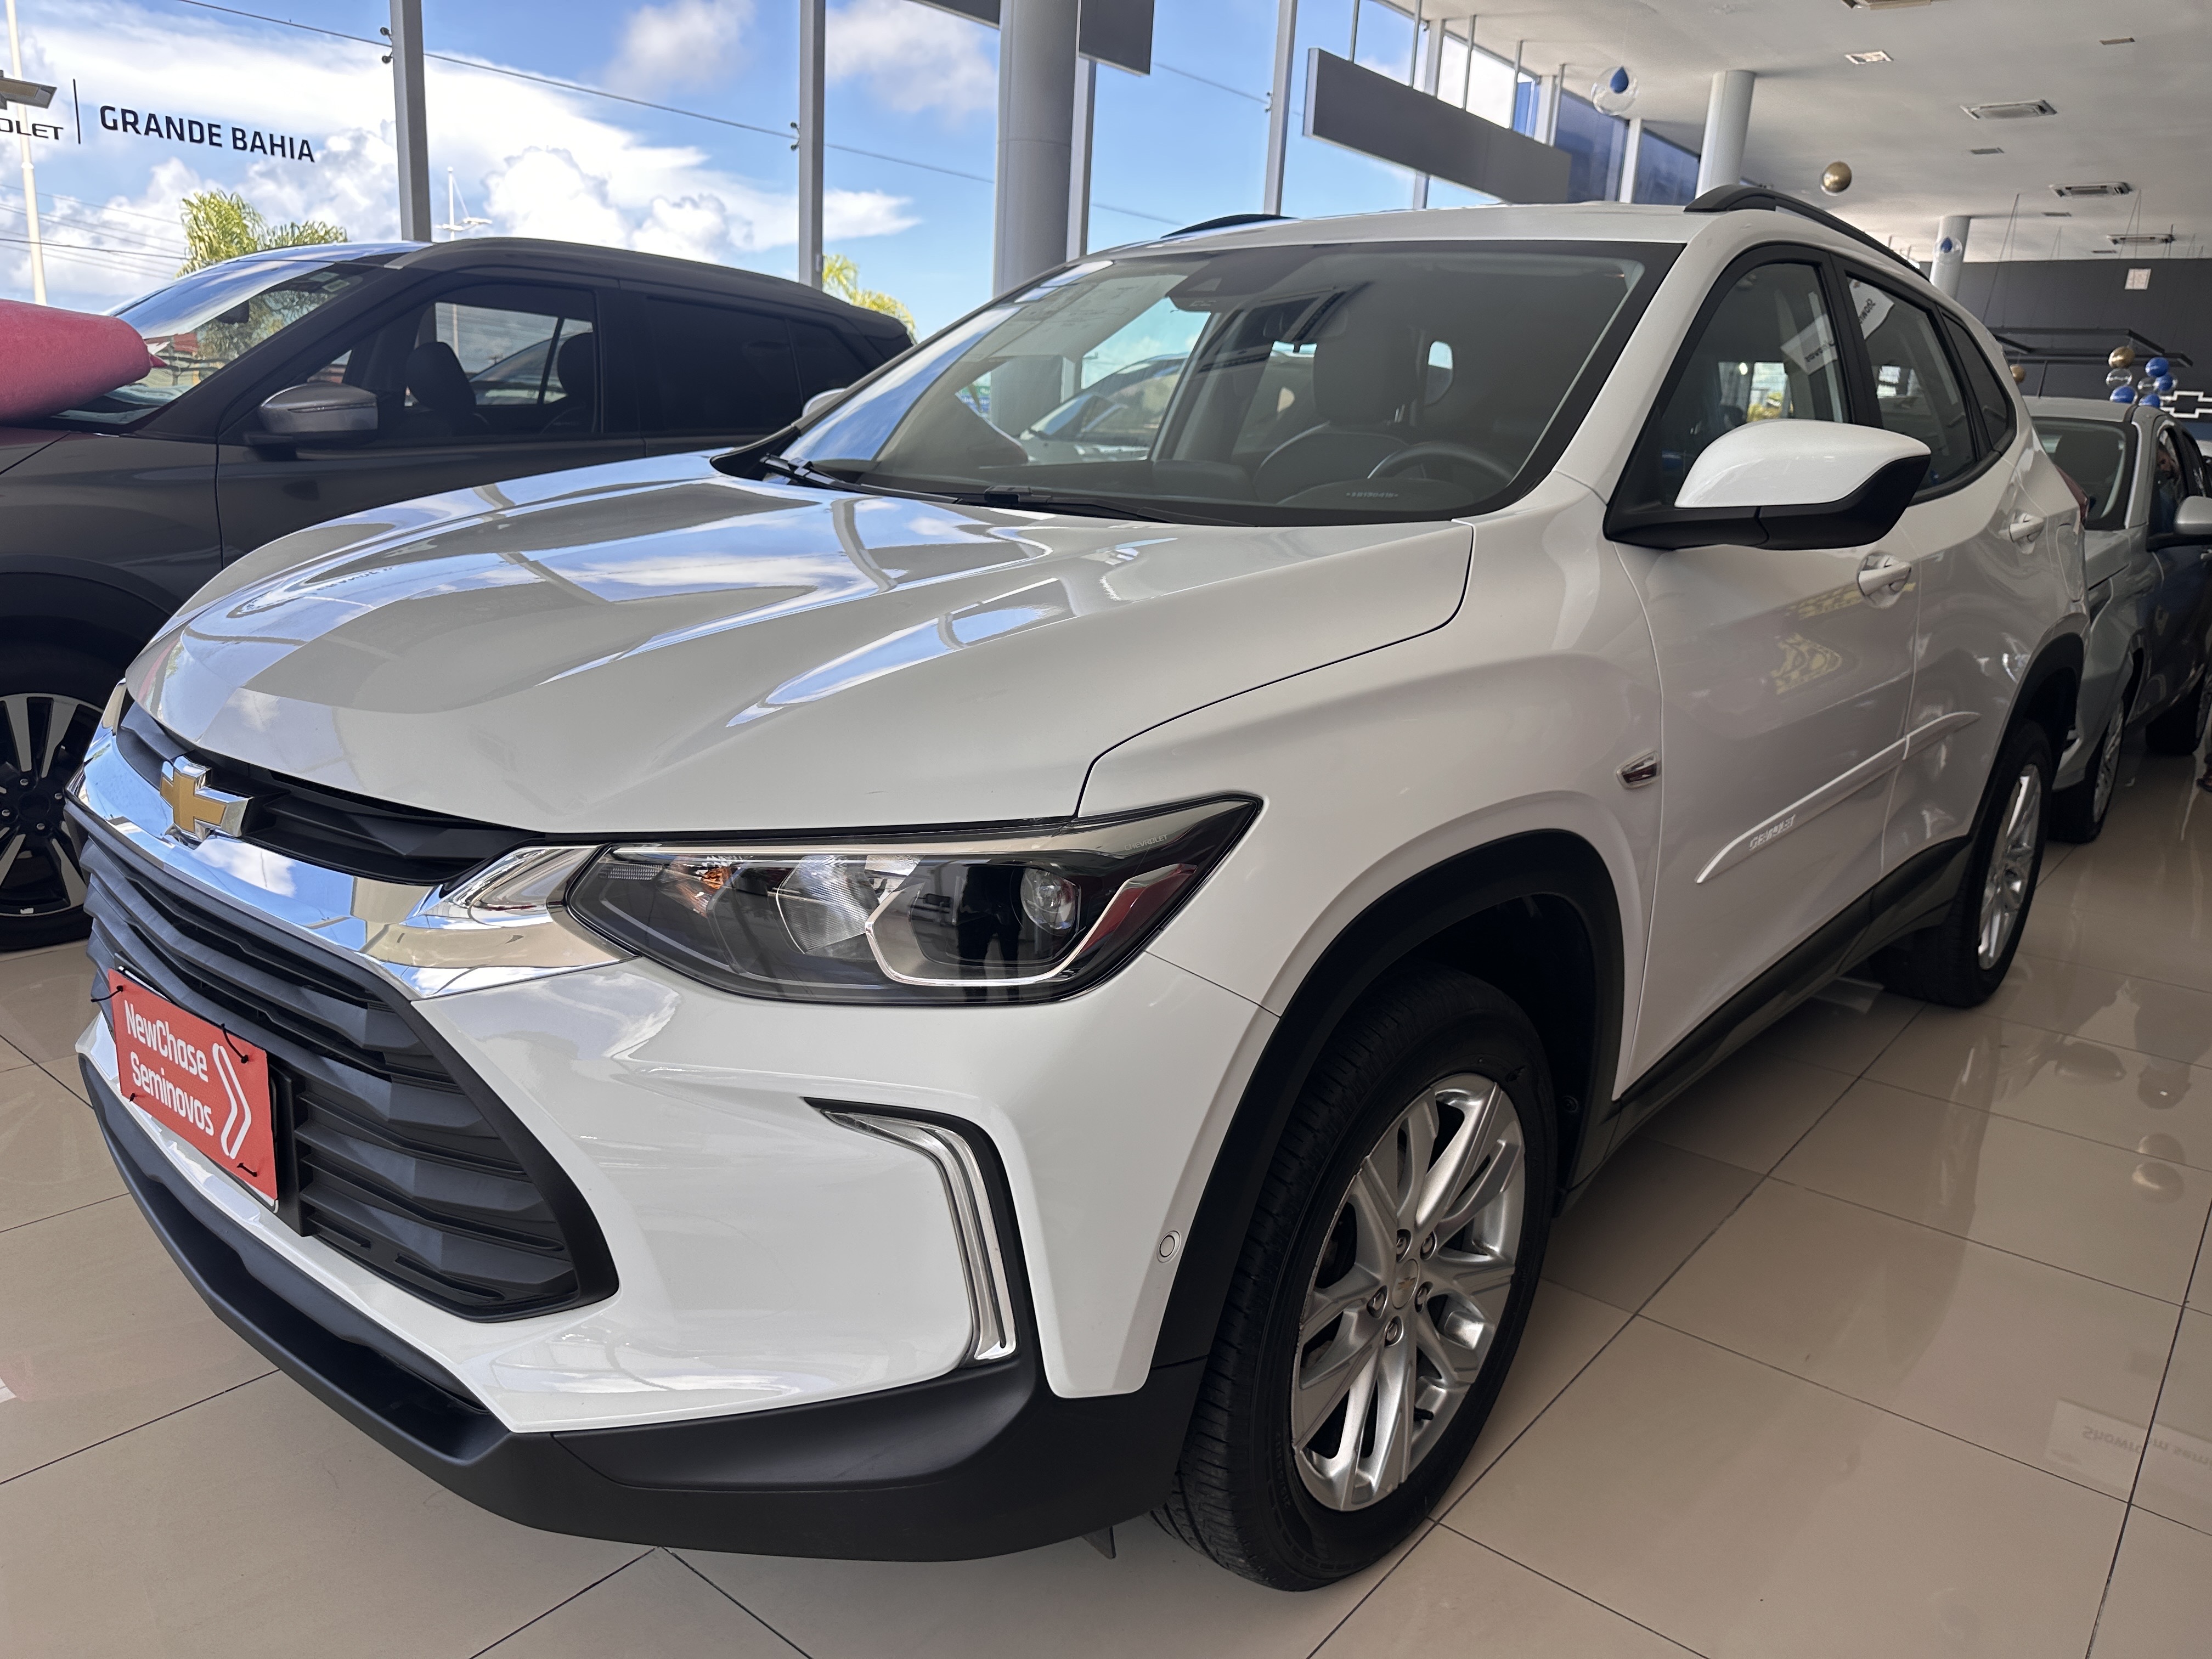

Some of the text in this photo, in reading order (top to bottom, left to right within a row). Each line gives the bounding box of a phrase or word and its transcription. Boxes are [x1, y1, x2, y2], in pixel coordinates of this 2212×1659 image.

[100, 105, 315, 163] GRANDE BAHIA
[1125, 834, 1167, 851] CHEVROLET
[124, 1000, 209, 1083] NewChase
[131, 1051, 215, 1137] Seminovos
